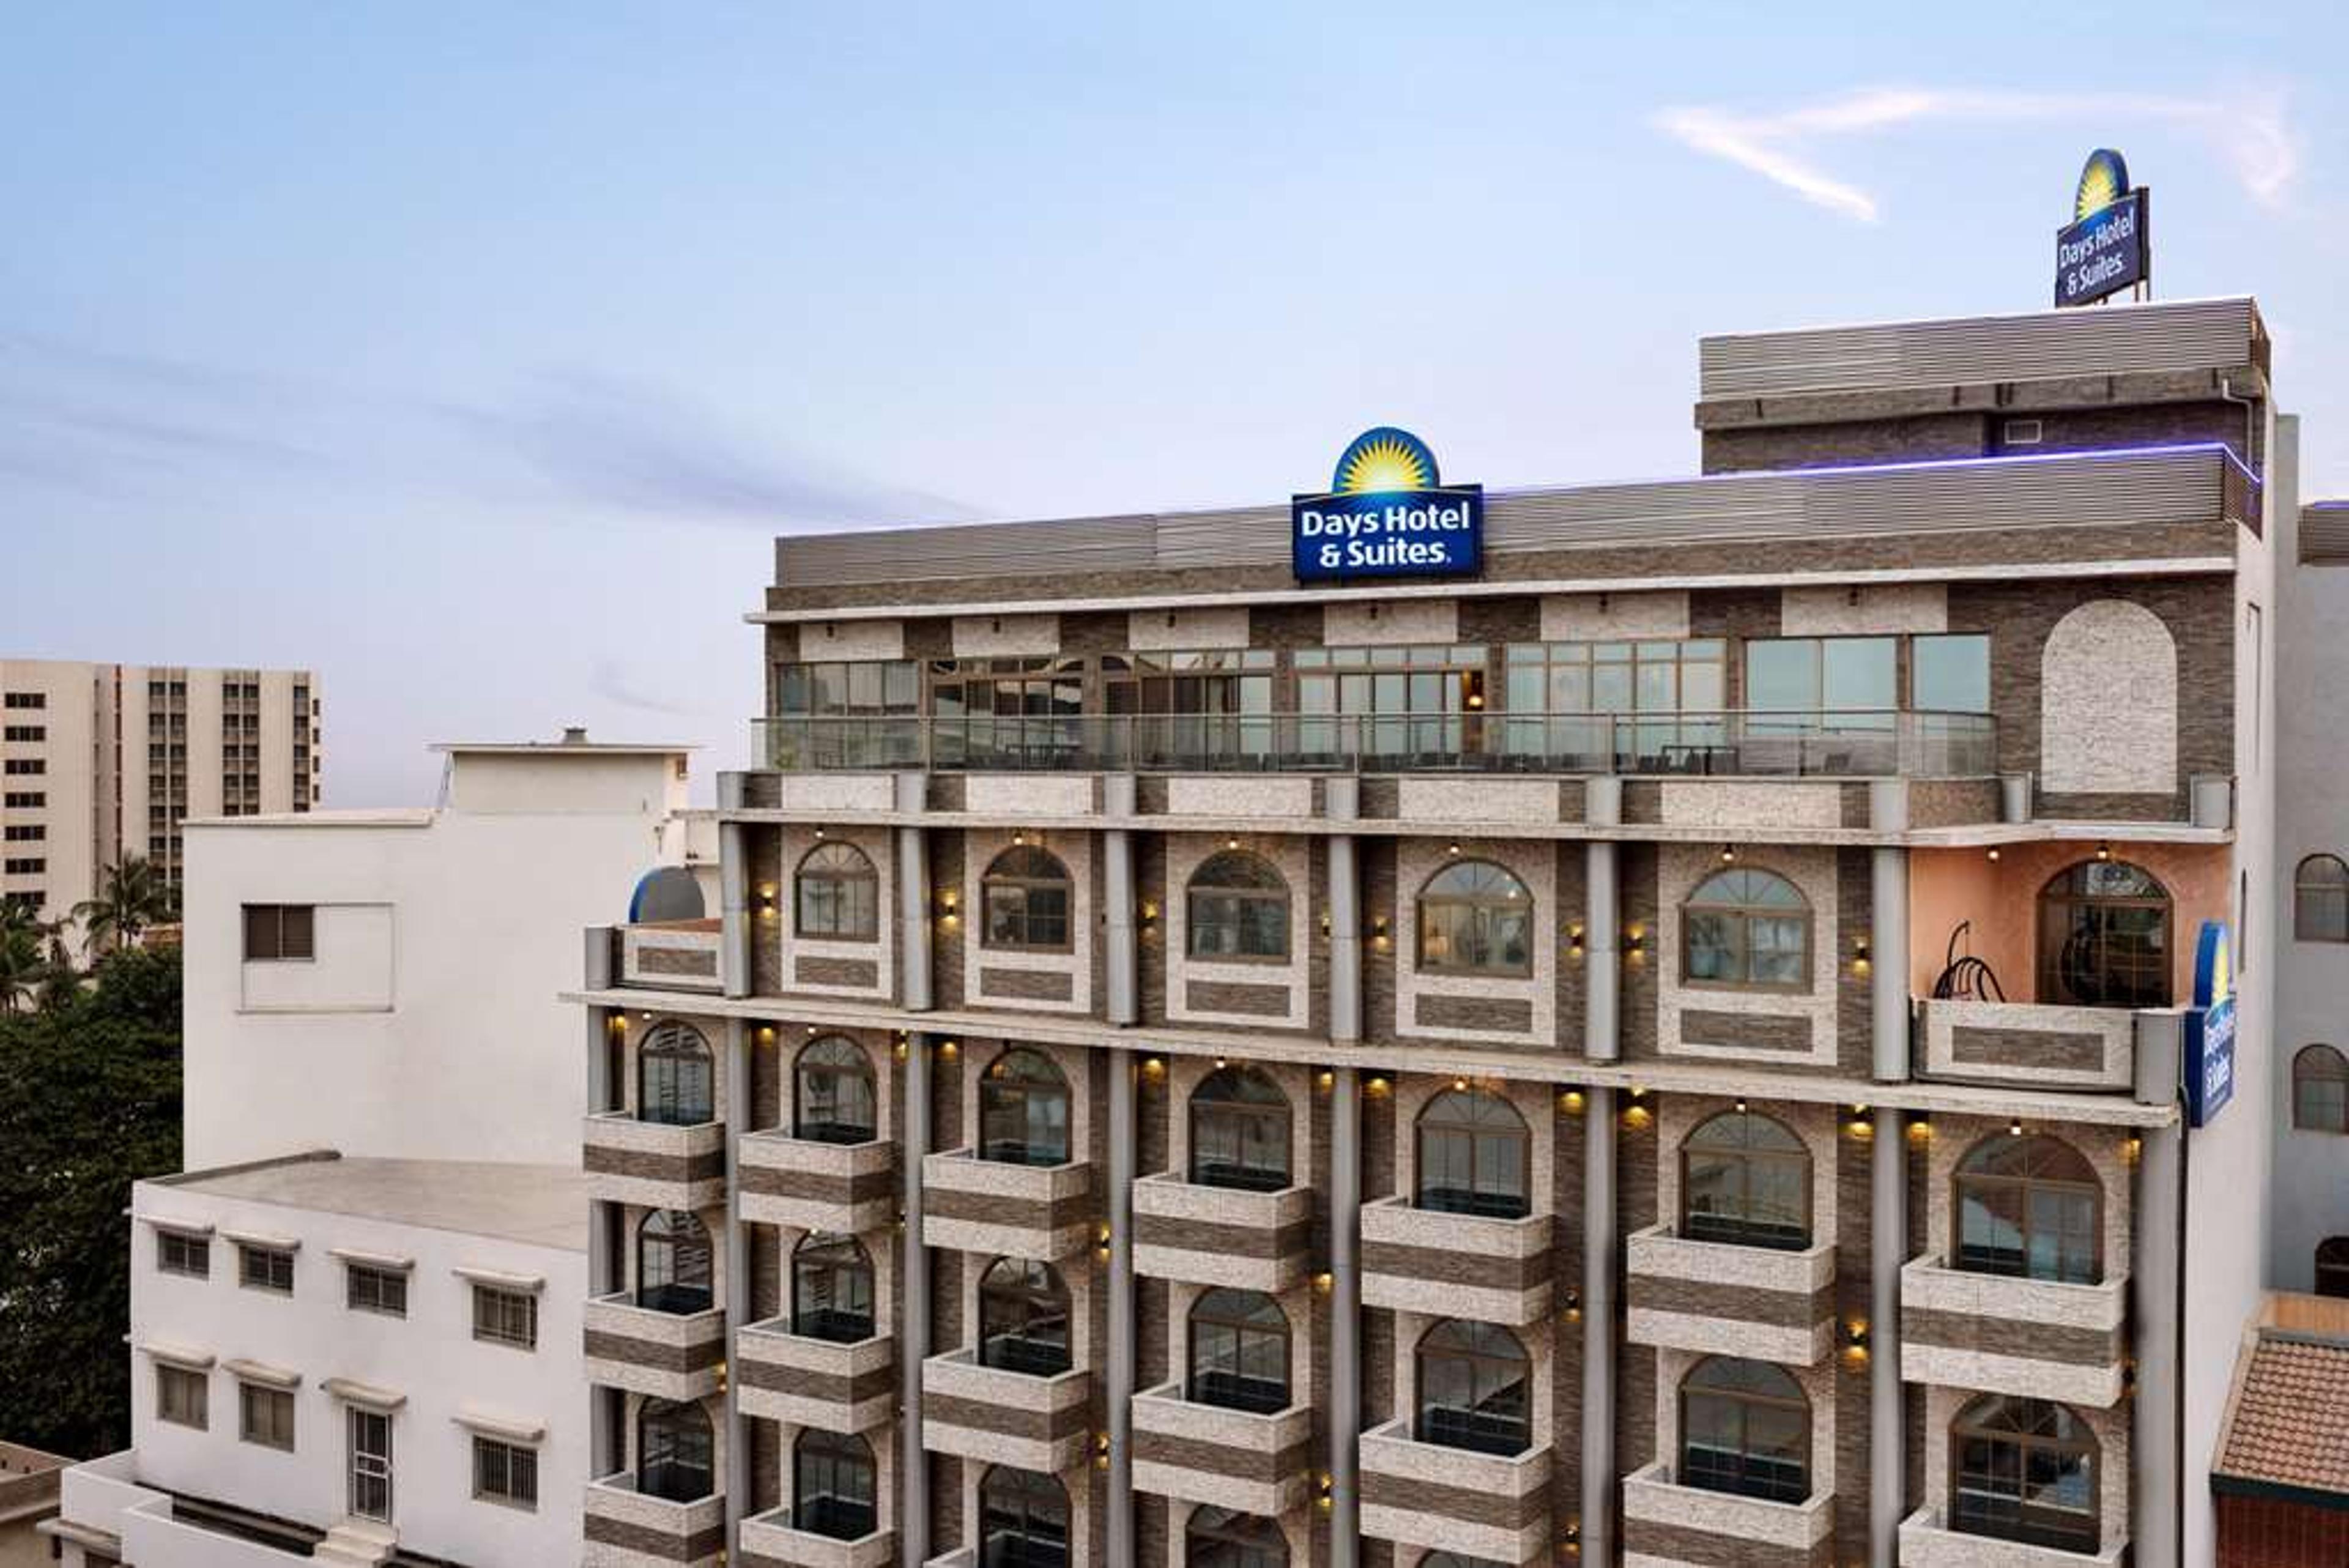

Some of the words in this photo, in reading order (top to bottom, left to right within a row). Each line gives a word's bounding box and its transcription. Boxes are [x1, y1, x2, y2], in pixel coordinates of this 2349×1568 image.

[2060, 236, 2095, 268] Days
[2096, 207, 2134, 250] Hotel
[2068, 272, 2078, 295] &
[1301, 511, 1379, 537] Days
[1386, 501, 1470, 532] Hotel
[1319, 544, 1341, 567] &
